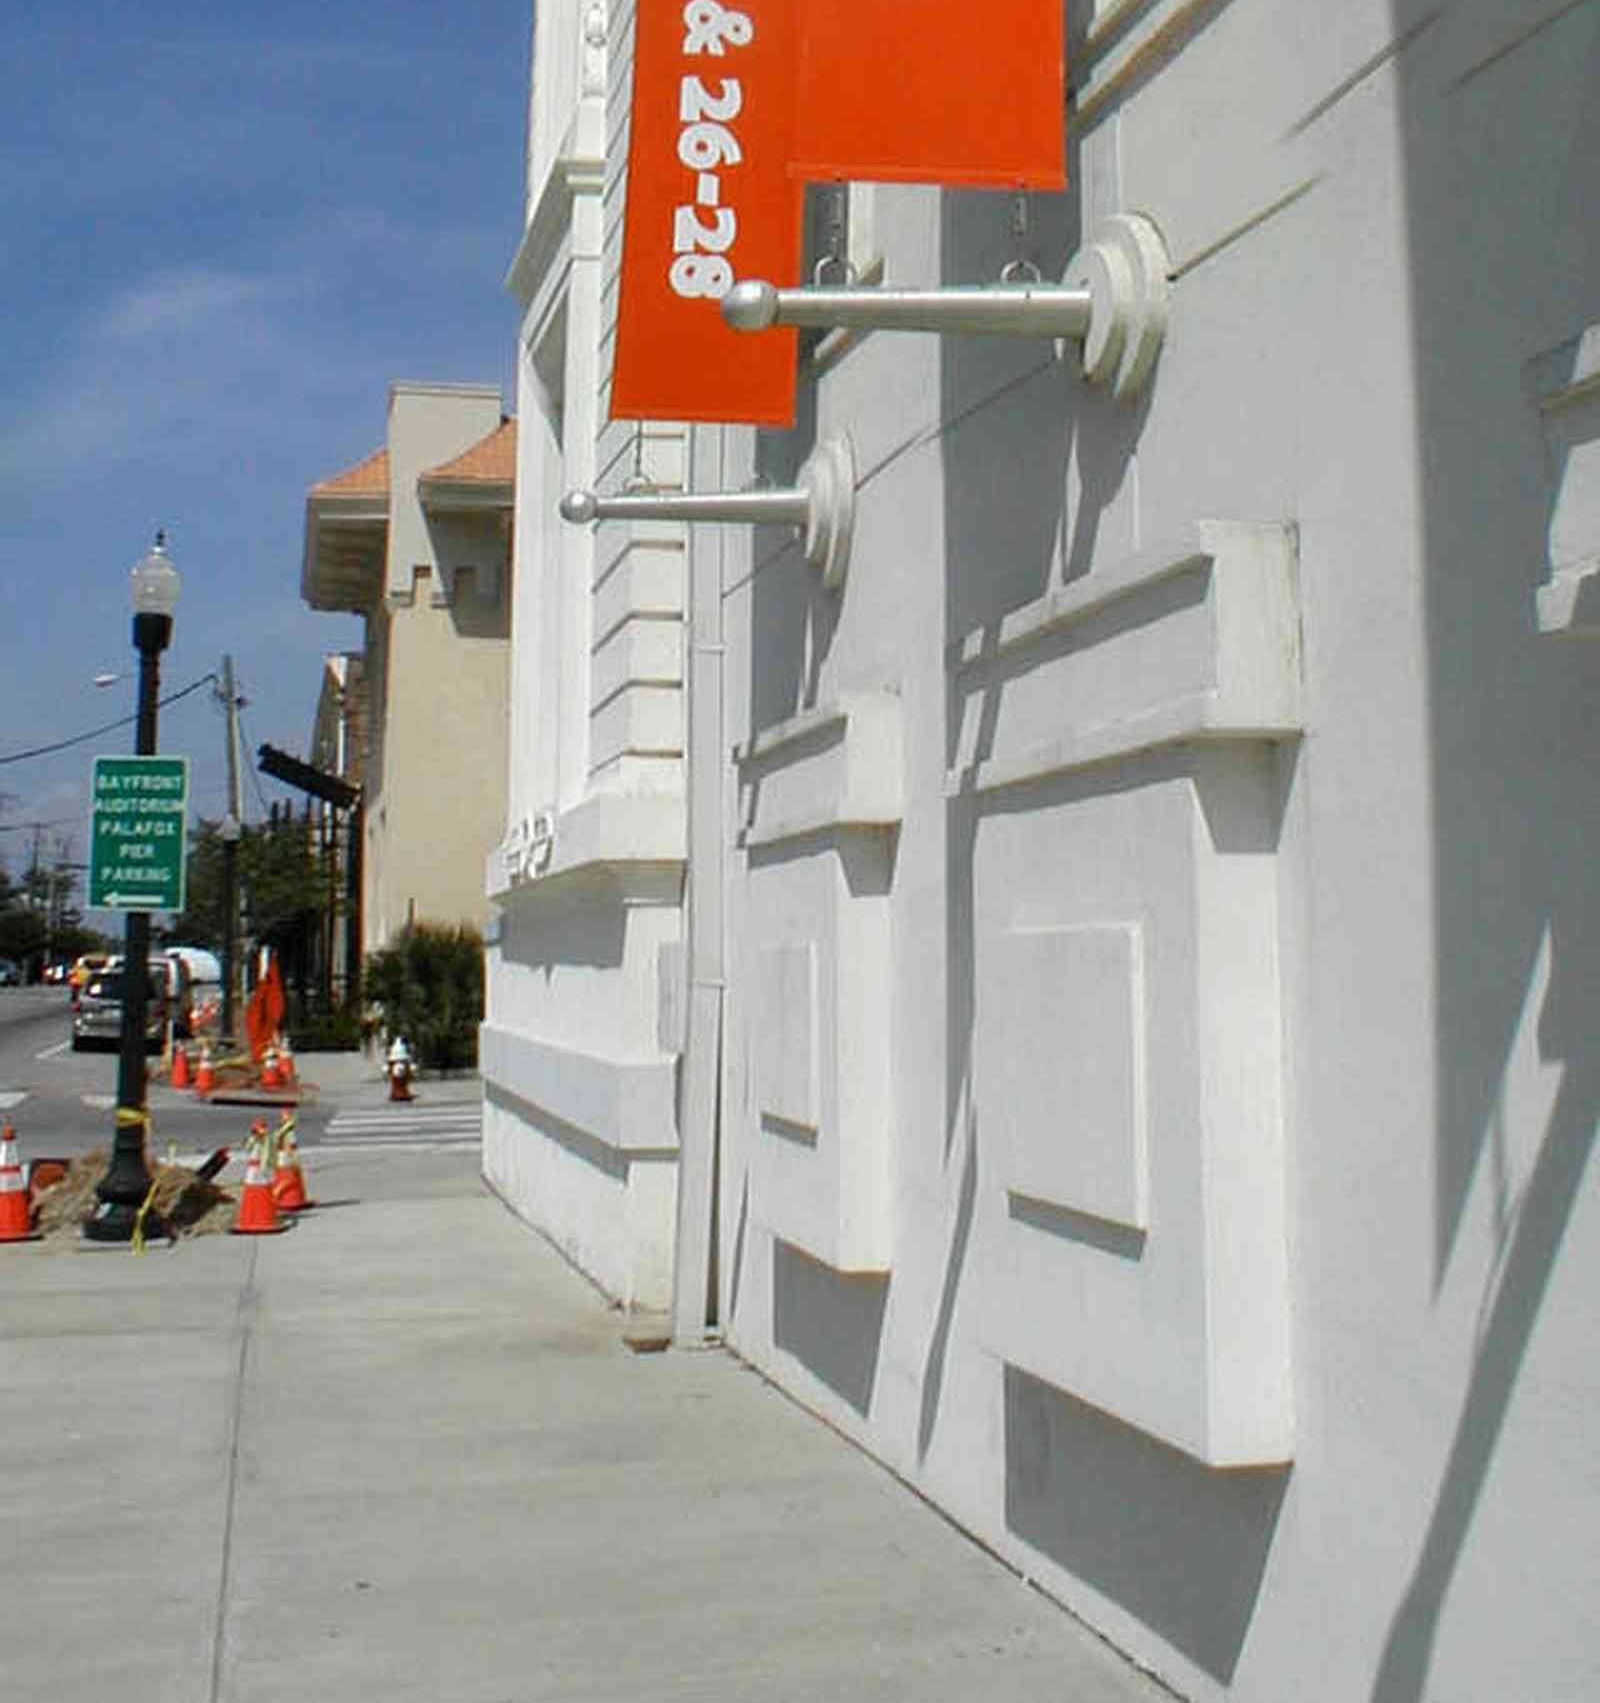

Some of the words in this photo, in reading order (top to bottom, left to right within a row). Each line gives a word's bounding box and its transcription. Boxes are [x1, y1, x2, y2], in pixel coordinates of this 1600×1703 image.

[668, 75, 743, 299] 26-28
[97, 774, 182, 791] BAYFRONT
[95, 798, 186, 813] AUDITORIUM
[100, 820, 176, 836] PALAFOX
[119, 843, 155, 859] PIER
[101, 866, 172, 883] PARKING
